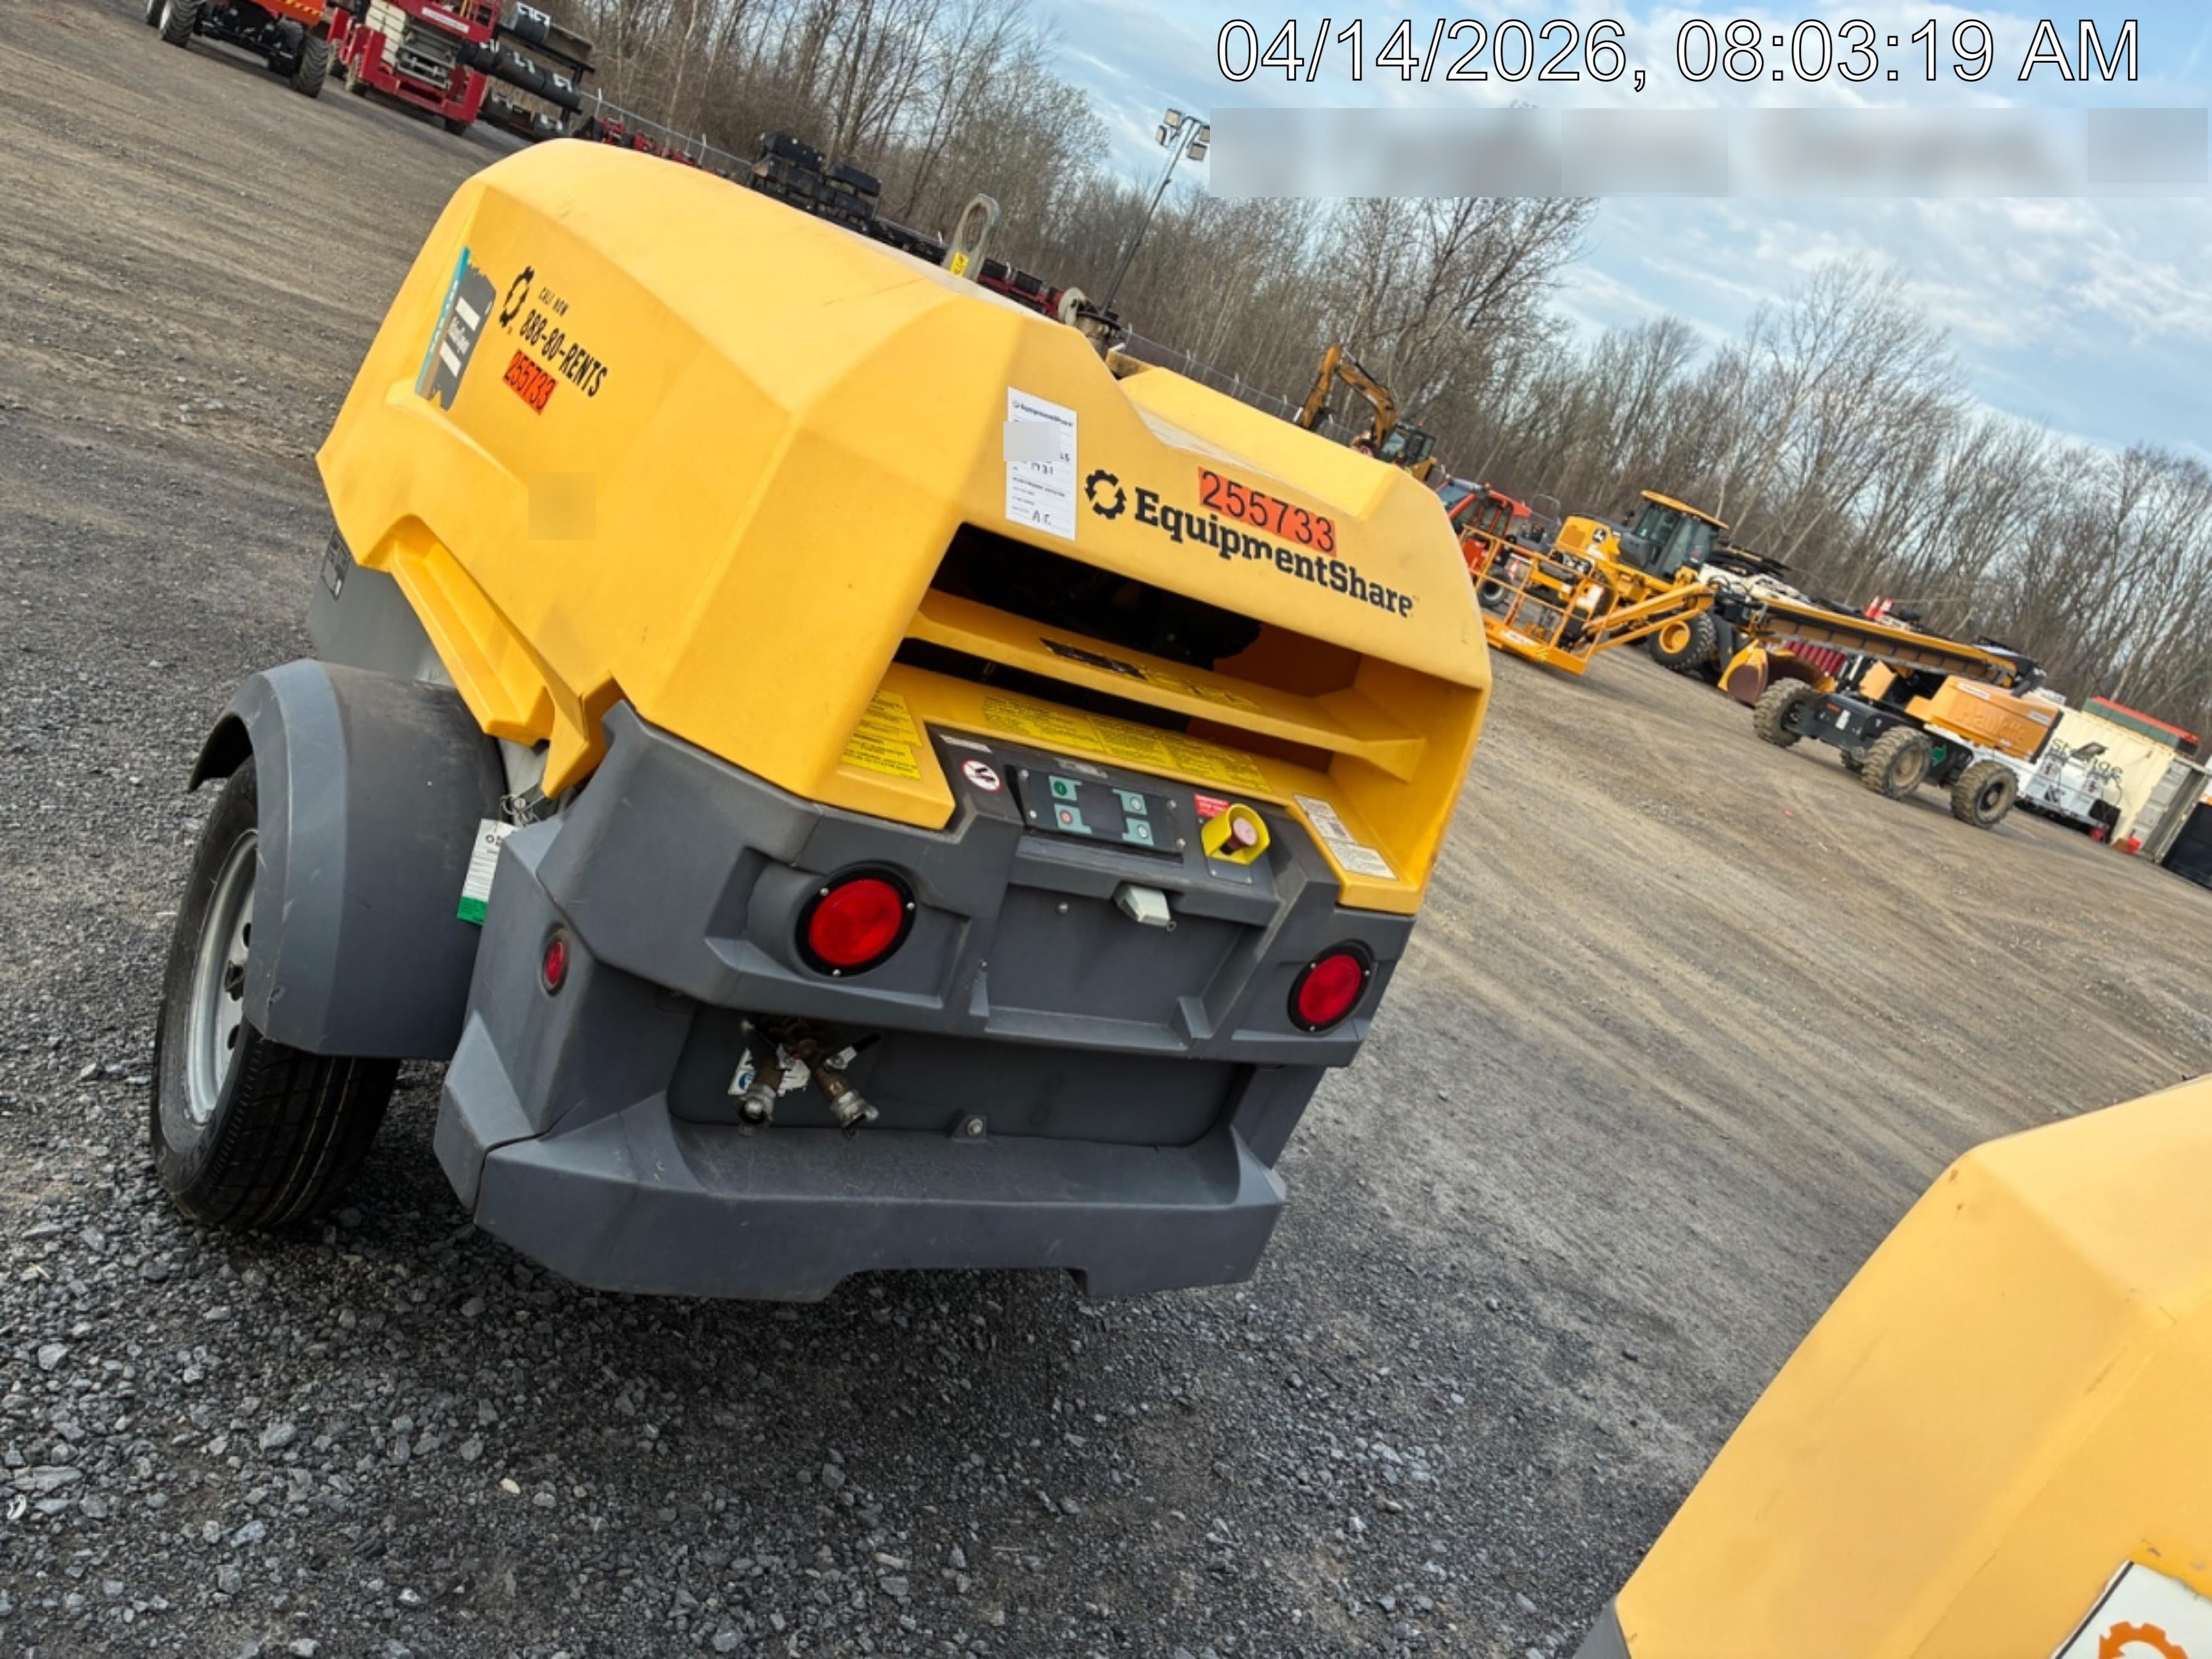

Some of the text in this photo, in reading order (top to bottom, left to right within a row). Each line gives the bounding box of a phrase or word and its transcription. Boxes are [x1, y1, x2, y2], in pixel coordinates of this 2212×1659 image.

[503, 350, 557, 411] 255733
[520, 308, 608, 398] 888-80-RENTS
[1134, 487, 1413, 618] EquipmentShare
[1199, 469, 1336, 554] 255733
[2052, 736, 2124, 780] Stge
